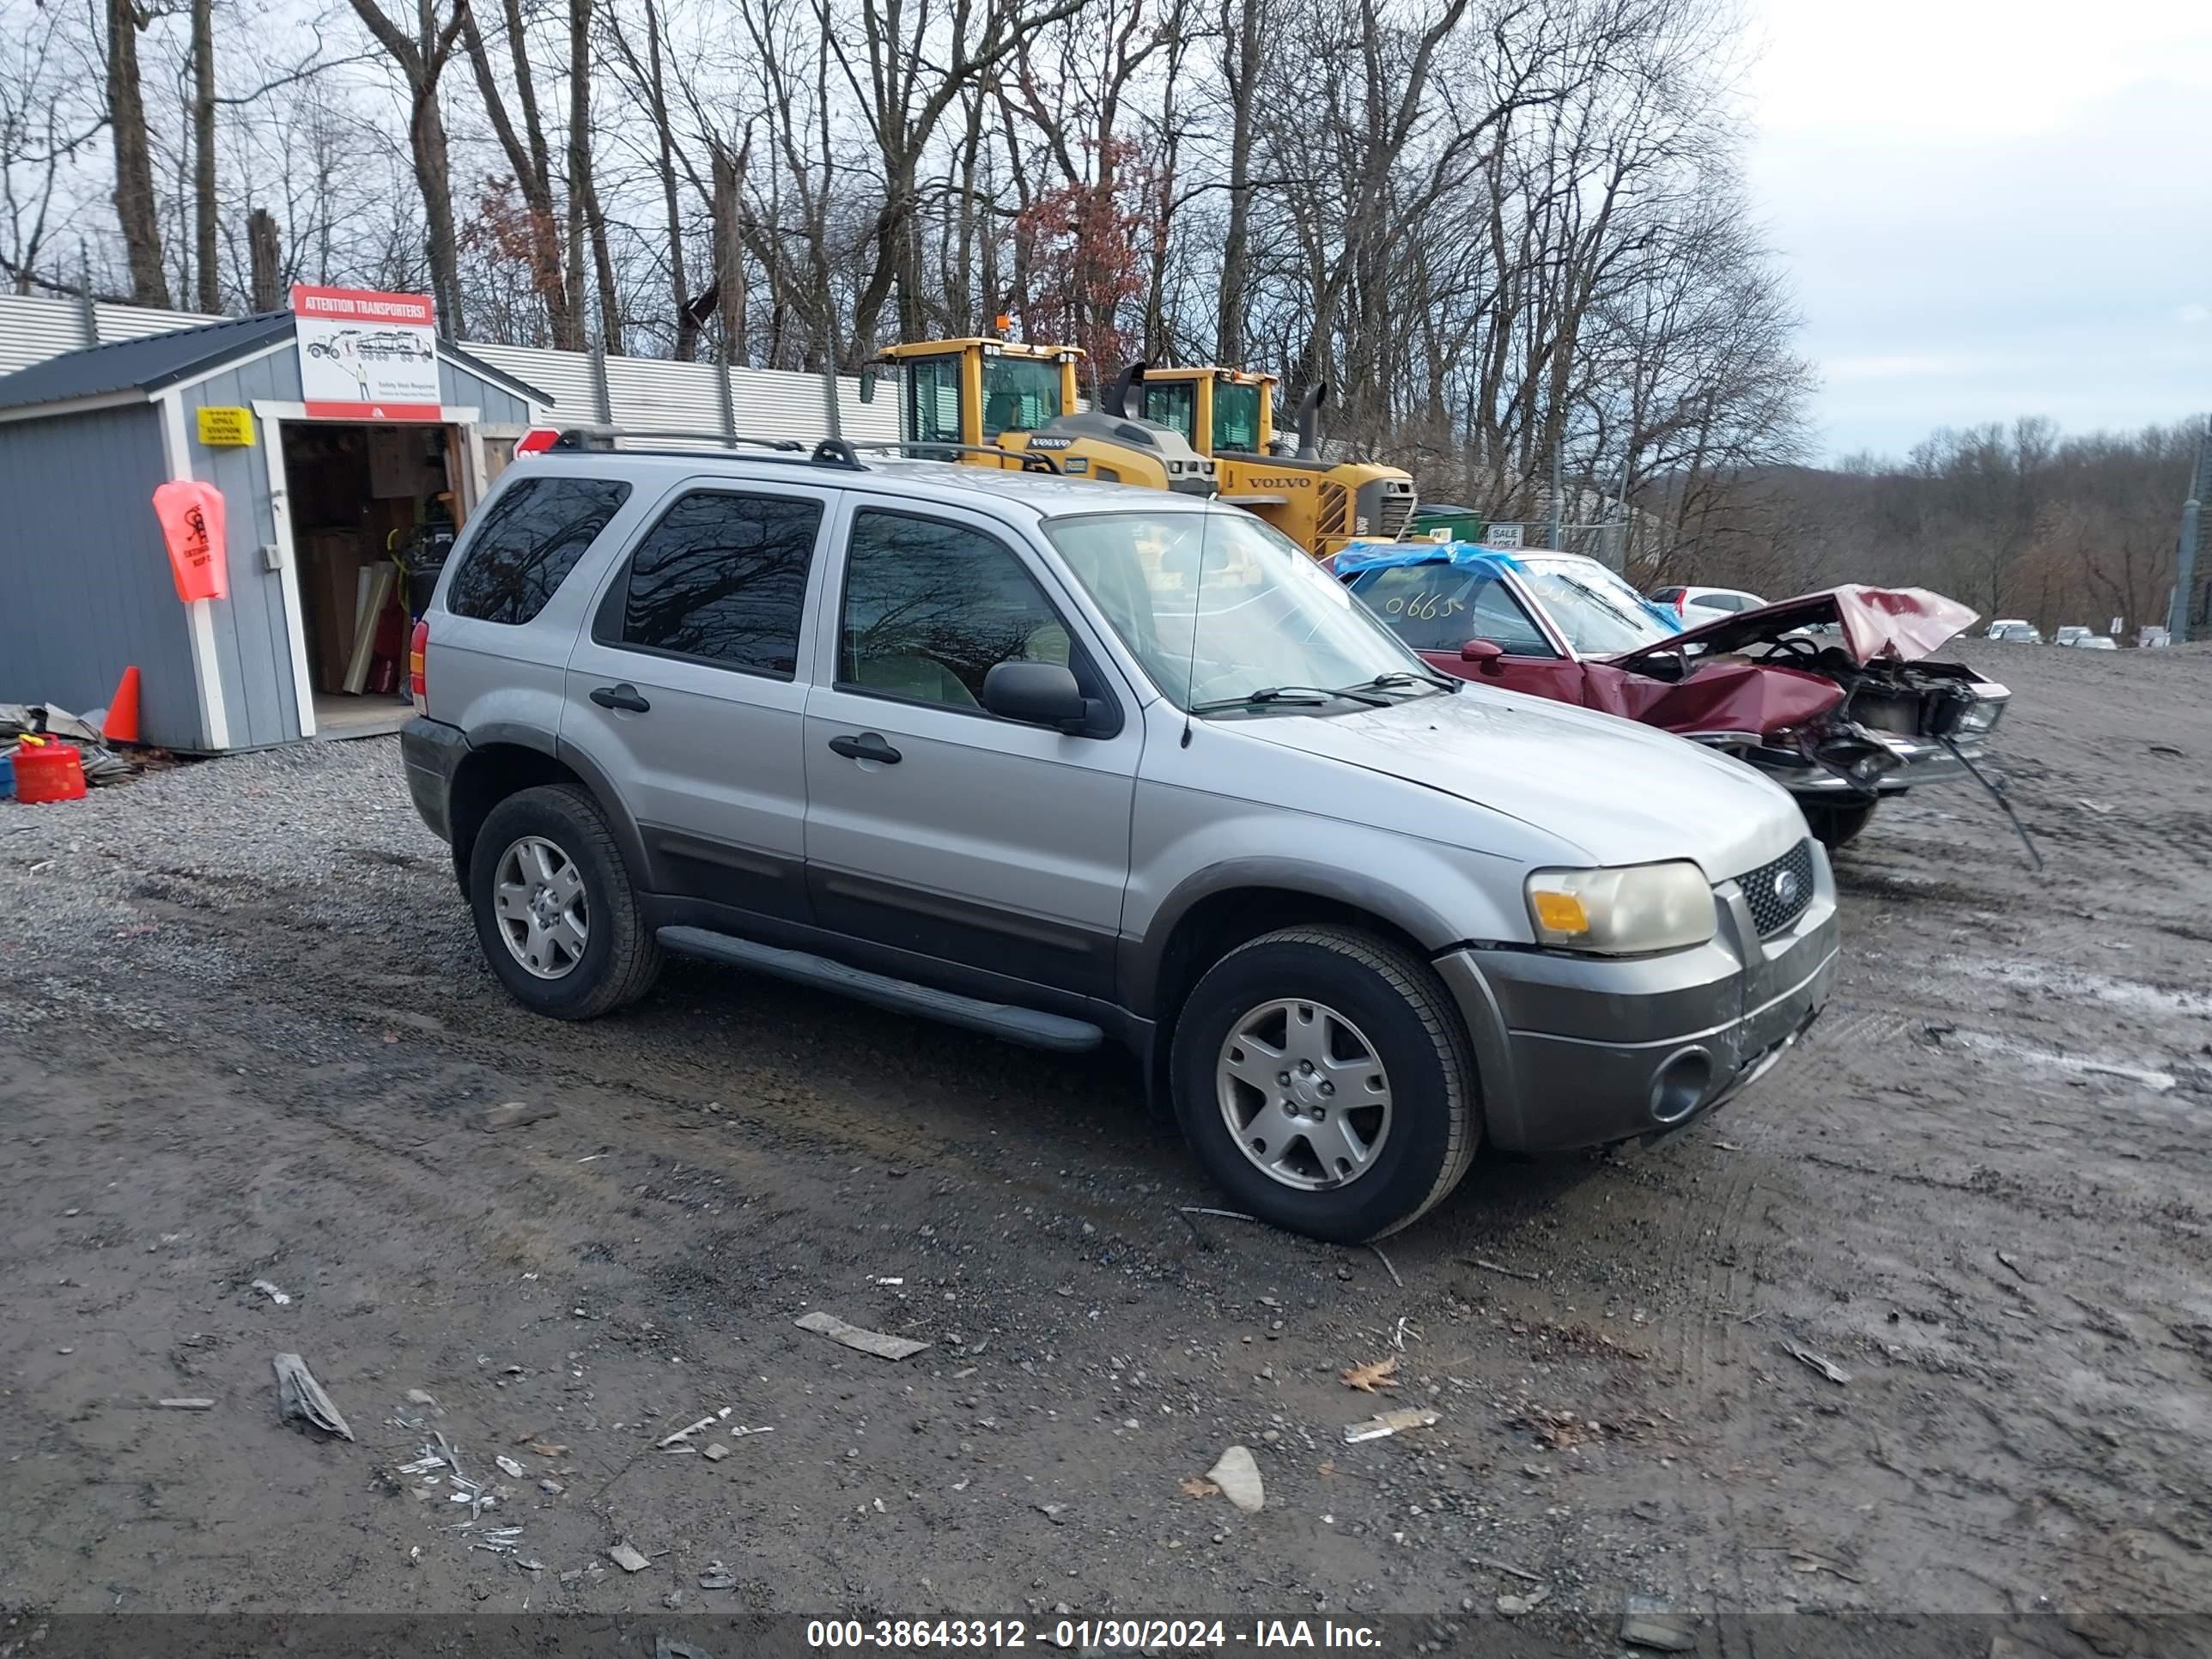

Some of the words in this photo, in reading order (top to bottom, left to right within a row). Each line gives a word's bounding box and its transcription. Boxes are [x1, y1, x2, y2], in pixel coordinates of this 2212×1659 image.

[305, 296, 355, 313] ATTENTION
[356, 301, 426, 319] TRANSPORTERS!
[1248, 477, 1311, 489] VOLVO
[1493, 528, 1519, 538] SALE
